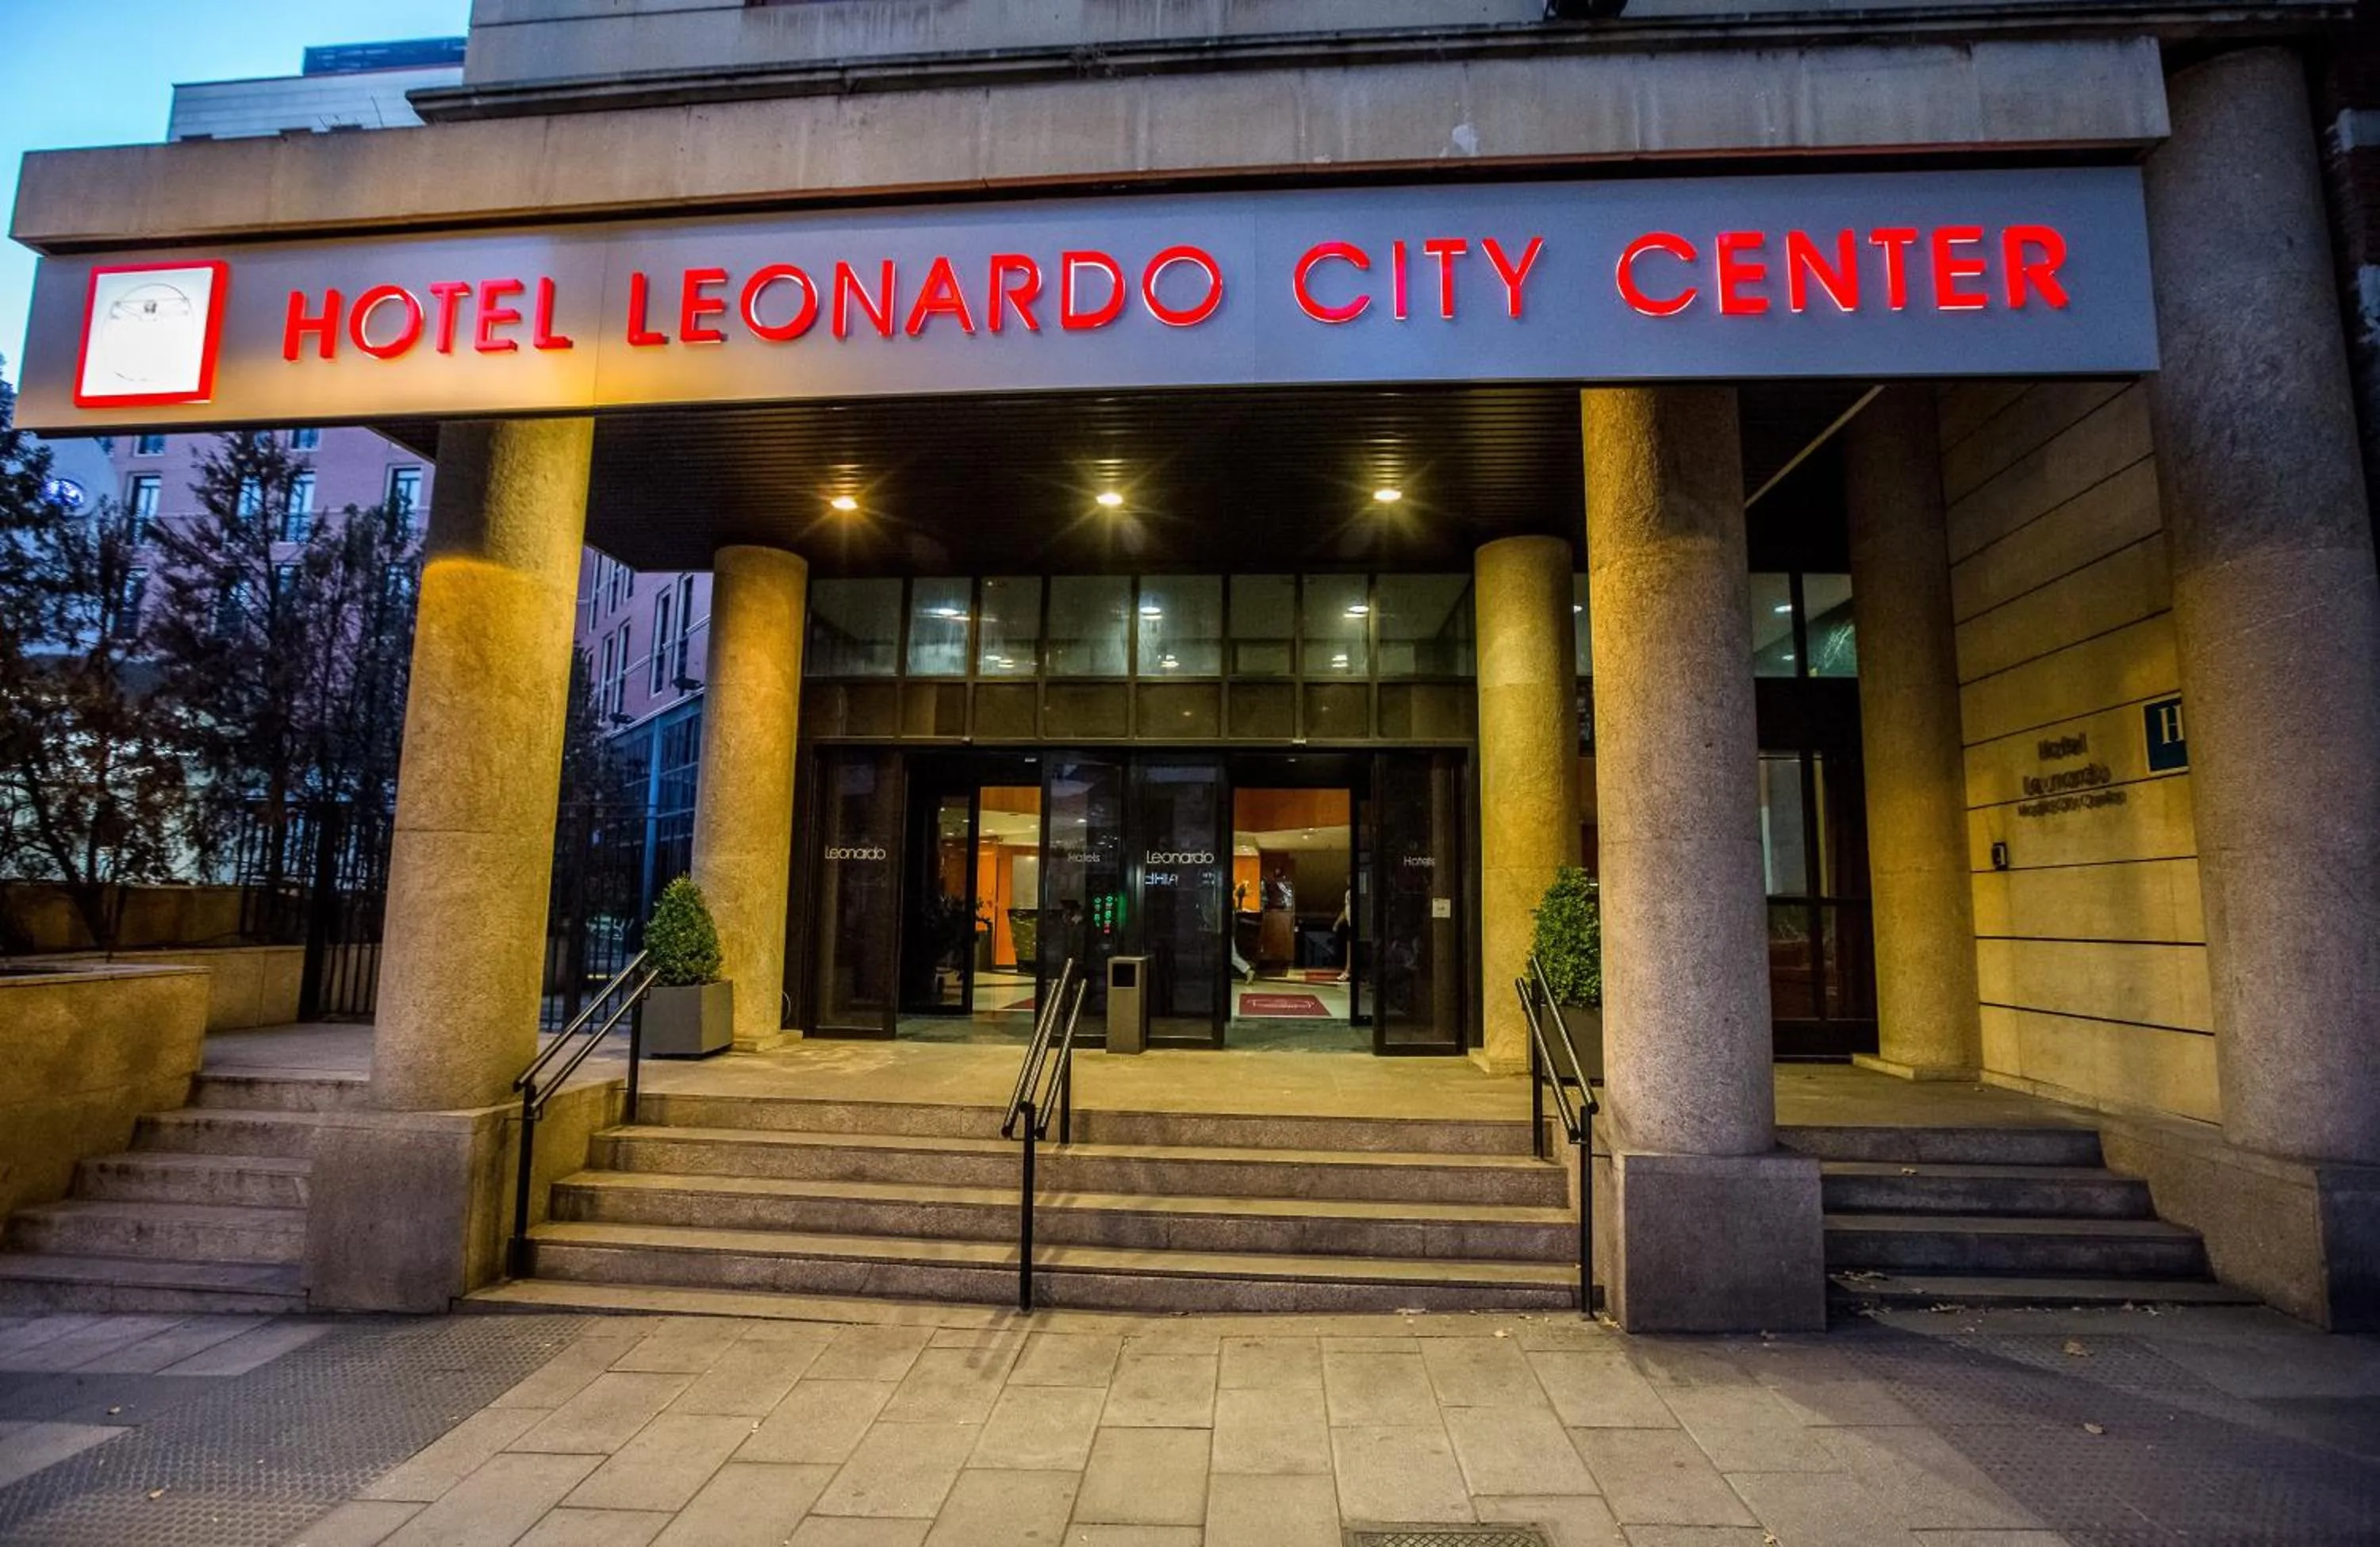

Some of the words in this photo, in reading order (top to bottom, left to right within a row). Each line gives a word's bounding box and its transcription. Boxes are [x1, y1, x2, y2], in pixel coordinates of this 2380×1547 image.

[282, 276, 574, 363] HOTEL
[625, 245, 1223, 349] LEONARDO
[1294, 237, 1543, 324] CITY
[1616, 225, 2070, 317] CENTER
[2159, 704, 2183, 744] H
[825, 845, 886, 861] Leonardo
[1146, 850, 1215, 864] Leonardo
